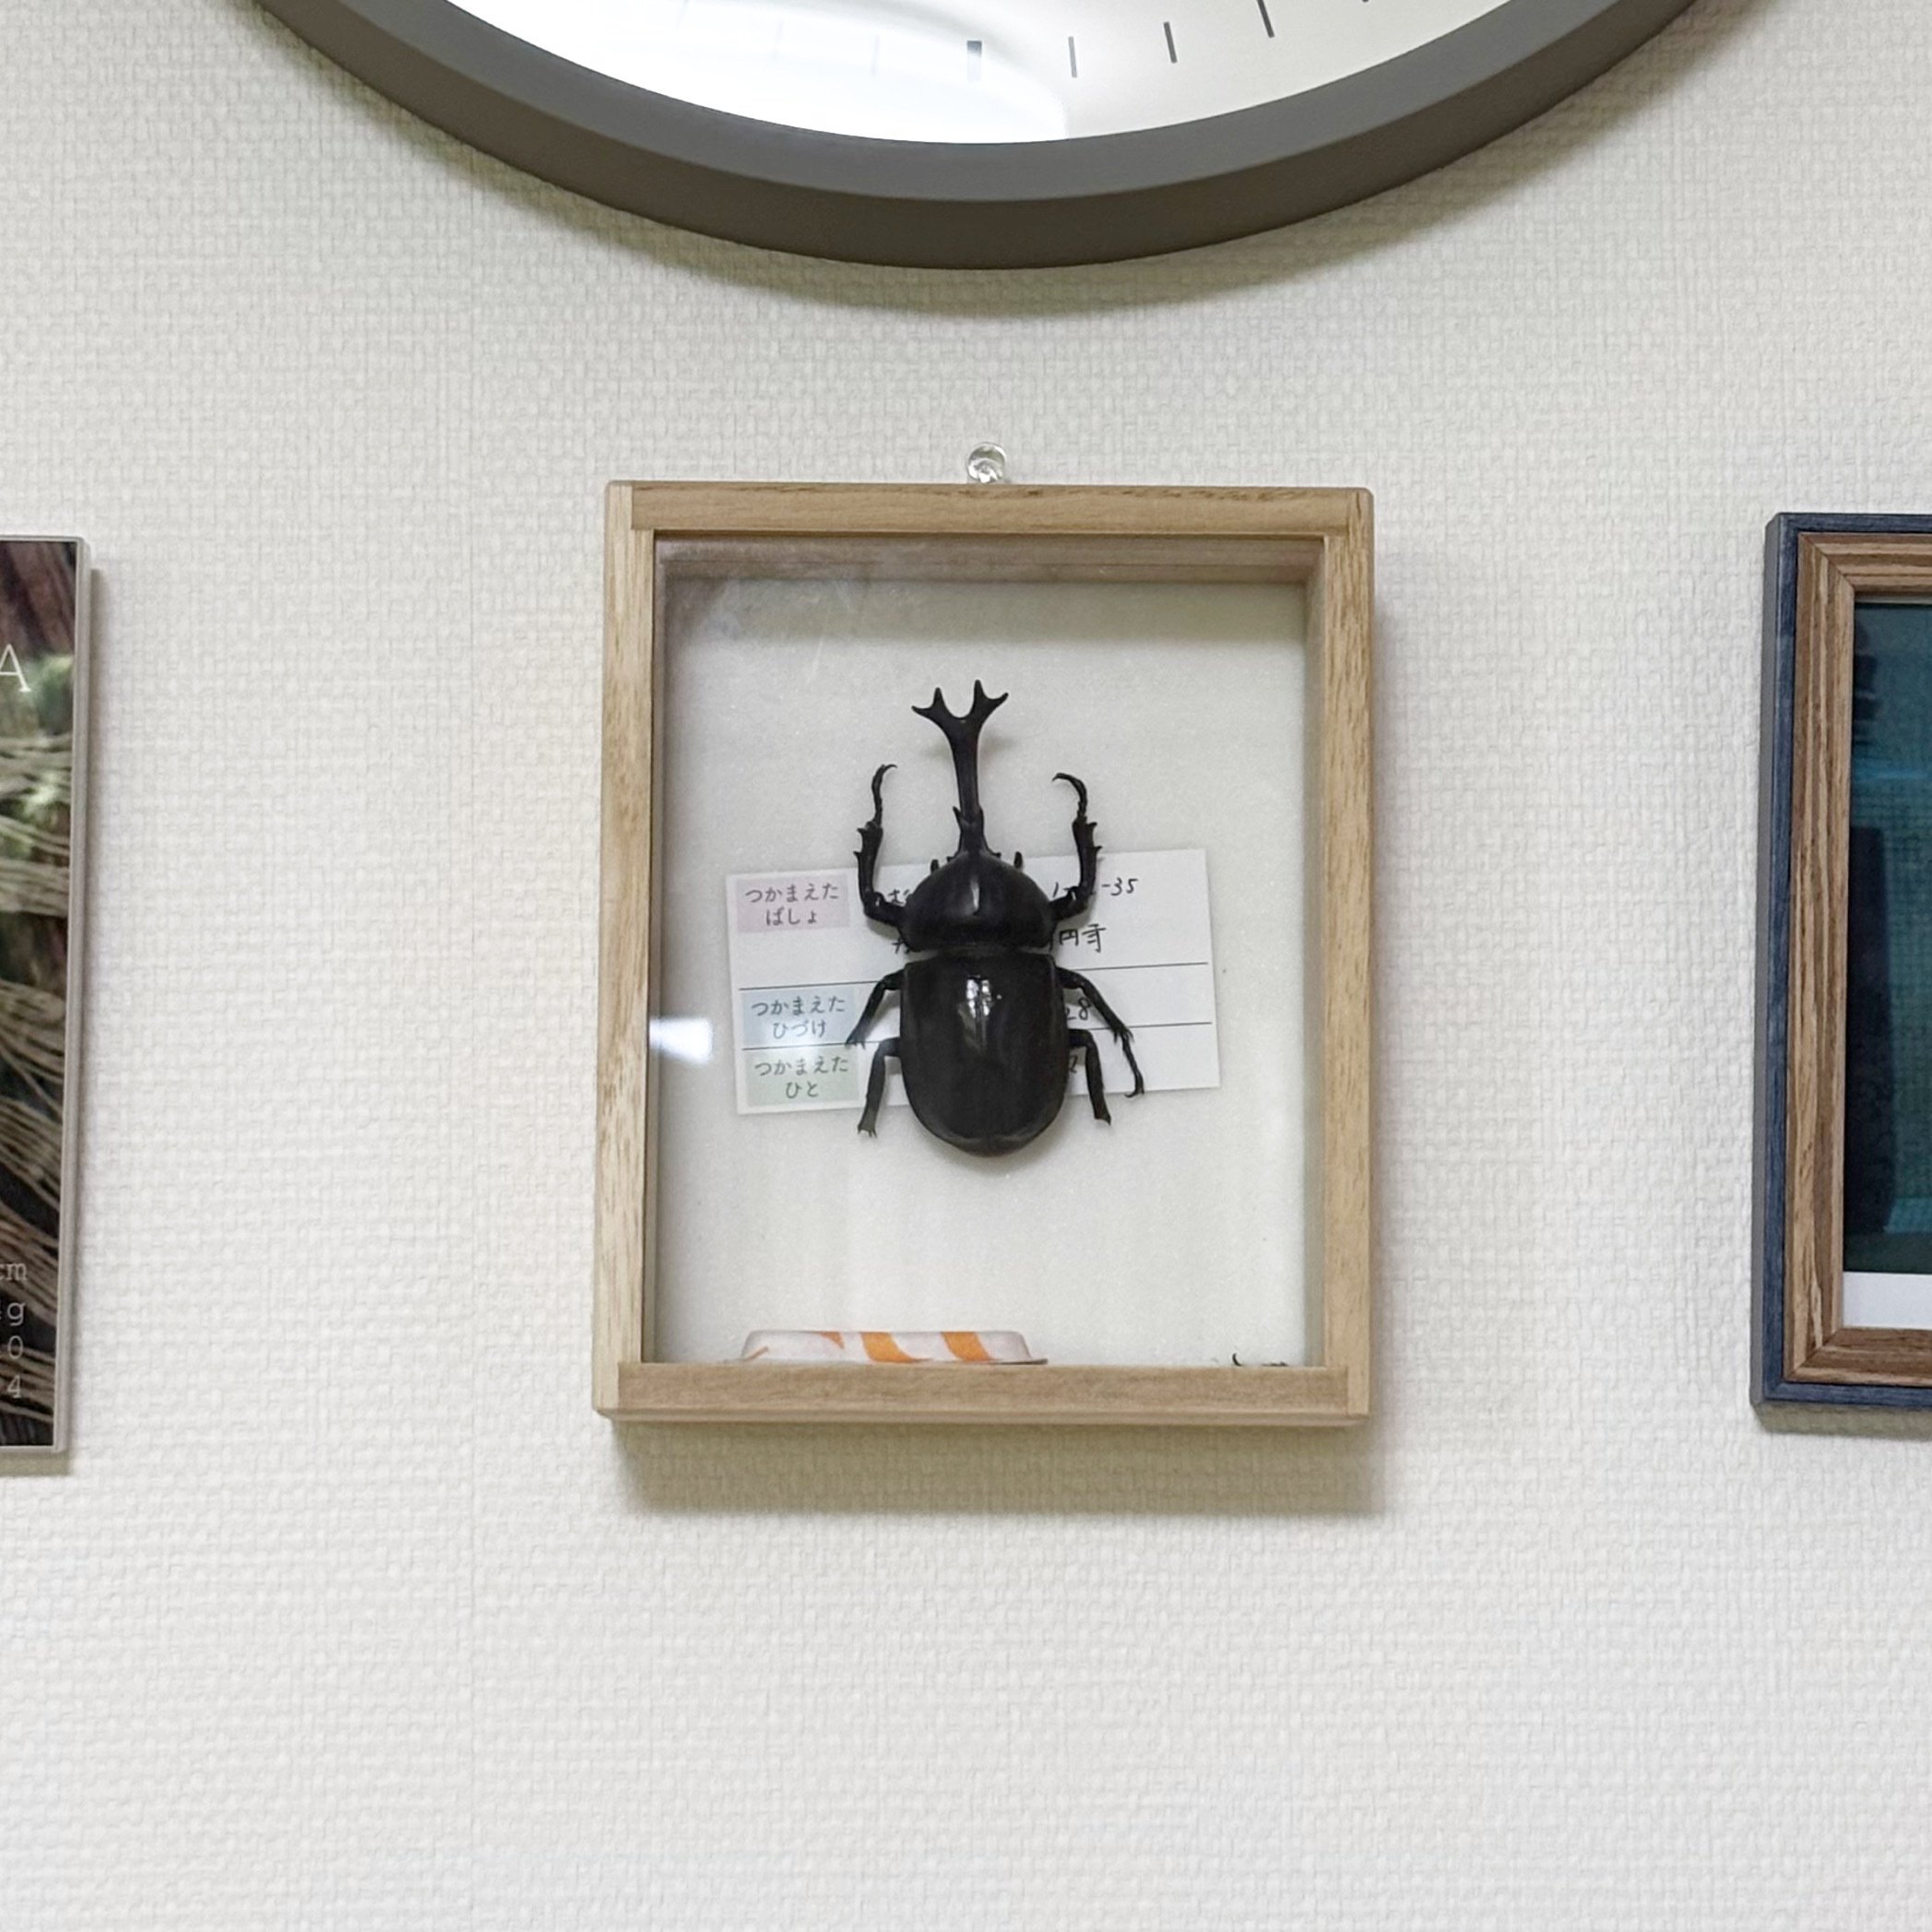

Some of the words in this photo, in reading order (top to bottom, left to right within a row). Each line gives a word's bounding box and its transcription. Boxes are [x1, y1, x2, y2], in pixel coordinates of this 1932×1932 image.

[0, 643, 31, 693] A
[745, 883, 839, 903] つかまえた
[765, 906, 818, 926] ばしょ
[751, 995, 846, 1016] つかまえた
[773, 1019, 826, 1039] ひづけ
[755, 1055, 848, 1076] つかまえた
[786, 1081, 820, 1099] ひと
